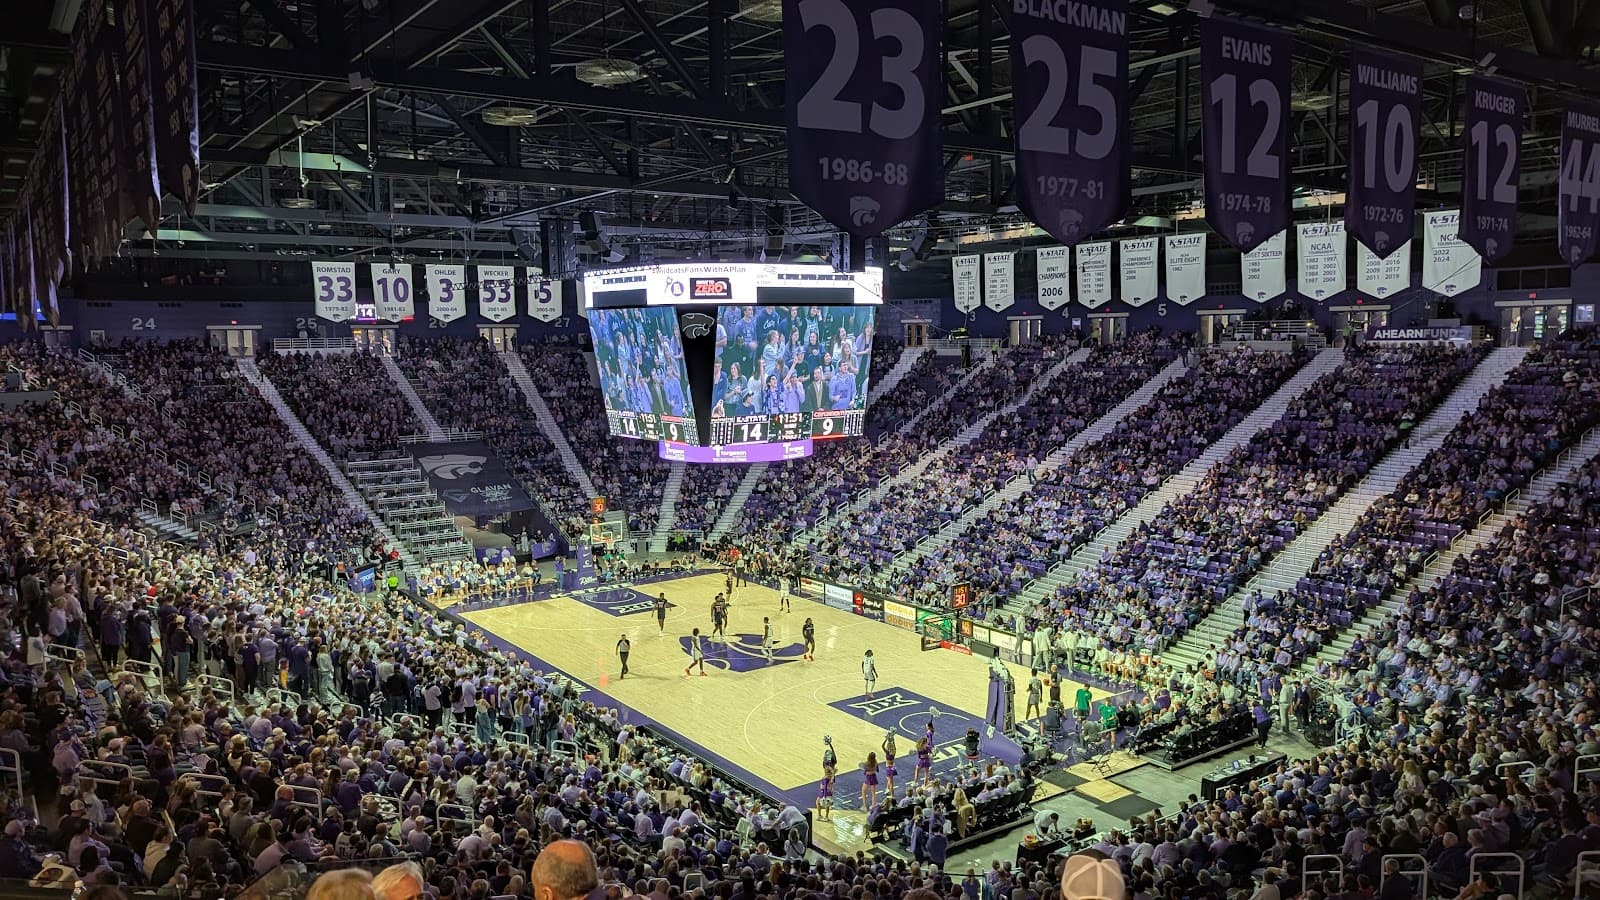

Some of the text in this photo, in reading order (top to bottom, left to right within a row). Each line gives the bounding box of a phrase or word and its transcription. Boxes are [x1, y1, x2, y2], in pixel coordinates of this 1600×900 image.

[1013, 0, 1127, 37] BLACKMAN
[1222, 35, 1272, 66] EVANS
[797, 0, 925, 139] 23
[1357, 64, 1418, 95] WILLIAMS
[1019, 34, 1118, 160] 25
[1474, 89, 1516, 115] KRUGER
[1210, 73, 1281, 179] 12
[1356, 99, 1415, 193] 10
[818, 156, 909, 186] 1986-88
[1471, 120, 1517, 204] 12
[1561, 138, 1600, 214] 44
[1037, 175, 1105, 201] 1977-81
[1218, 192, 1271, 214] 1974-78
[1363, 204, 1404, 224] 1972-76
[1302, 224, 1343, 235] K-STATE
[1476, 215, 1509, 232] 1971-74
[1079, 245, 1107, 254] K-STATE
[1123, 241, 1154, 250] K-STATE
[1169, 237, 1202, 248] K-STATE
[1310, 242, 1332, 251] NCAA
[1039, 249, 1065, 257] K-STATE
[317, 276, 352, 302] 33
[376, 277, 409, 302] 10
[439, 278, 454, 303] 3
[482, 279, 511, 303] 53
[538, 281, 552, 304] 5
[695, 284, 724, 293] ZERO
[1041, 287, 1063, 297] 2006
[361, 309, 373, 317] 14
[969, 311, 976, 322] 3
[1062, 306, 1069, 319] 4
[1158, 303, 1167, 316] 5
[132, 317, 156, 330] 24
[295, 317, 317, 330] 25
[555, 317, 570, 328] 27
[622, 418, 636, 435] 14
[736, 414, 768, 423] K-STATE
[778, 412, 803, 424] 11:51
[822, 418, 834, 436] 9
[669, 423, 678, 441] 9
[741, 423, 762, 442] 14
[470, 483, 512, 494] GLAVAN
[955, 594, 966, 606] 30
